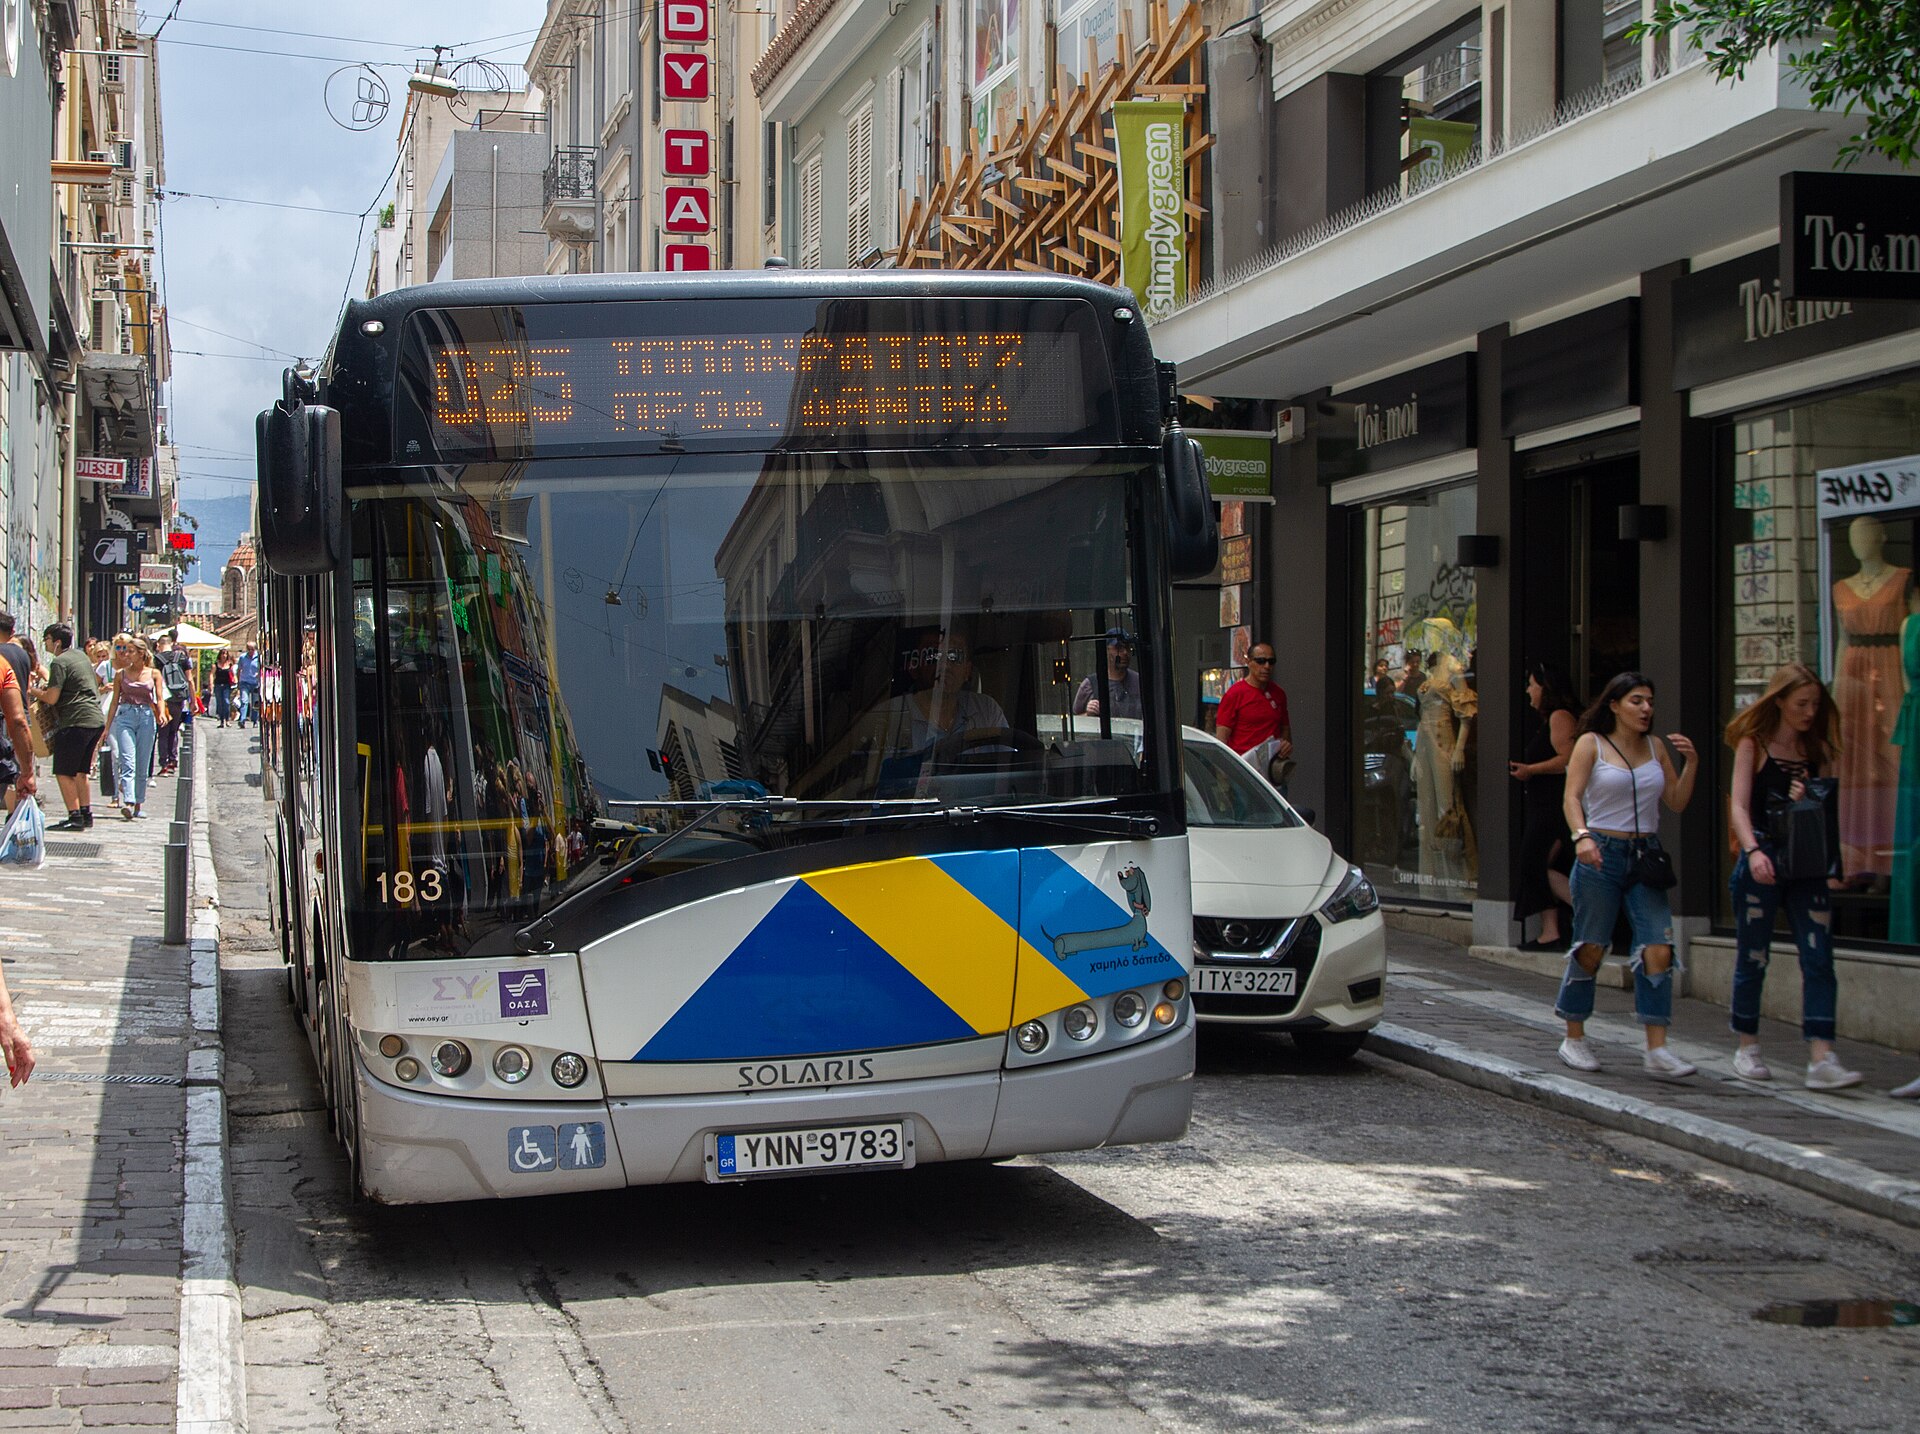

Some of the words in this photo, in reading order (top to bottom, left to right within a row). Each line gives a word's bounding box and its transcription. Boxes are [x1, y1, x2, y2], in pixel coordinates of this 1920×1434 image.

[1145, 123, 1181, 312] simplygreen
[436, 349, 572, 424] 025
[76, 461, 120, 475] DIESEL
[377, 869, 442, 903] 183
[1090, 957, 1129, 973] χαμηλό
[1132, 953, 1171, 966] δάπεδο
[508, 1000, 538, 1010] ΟΑΣΑ
[408, 1015, 449, 1023] www.osy.gr
[738, 1058, 874, 1088] SOLARIS
[720, 1158, 734, 1168] GR
